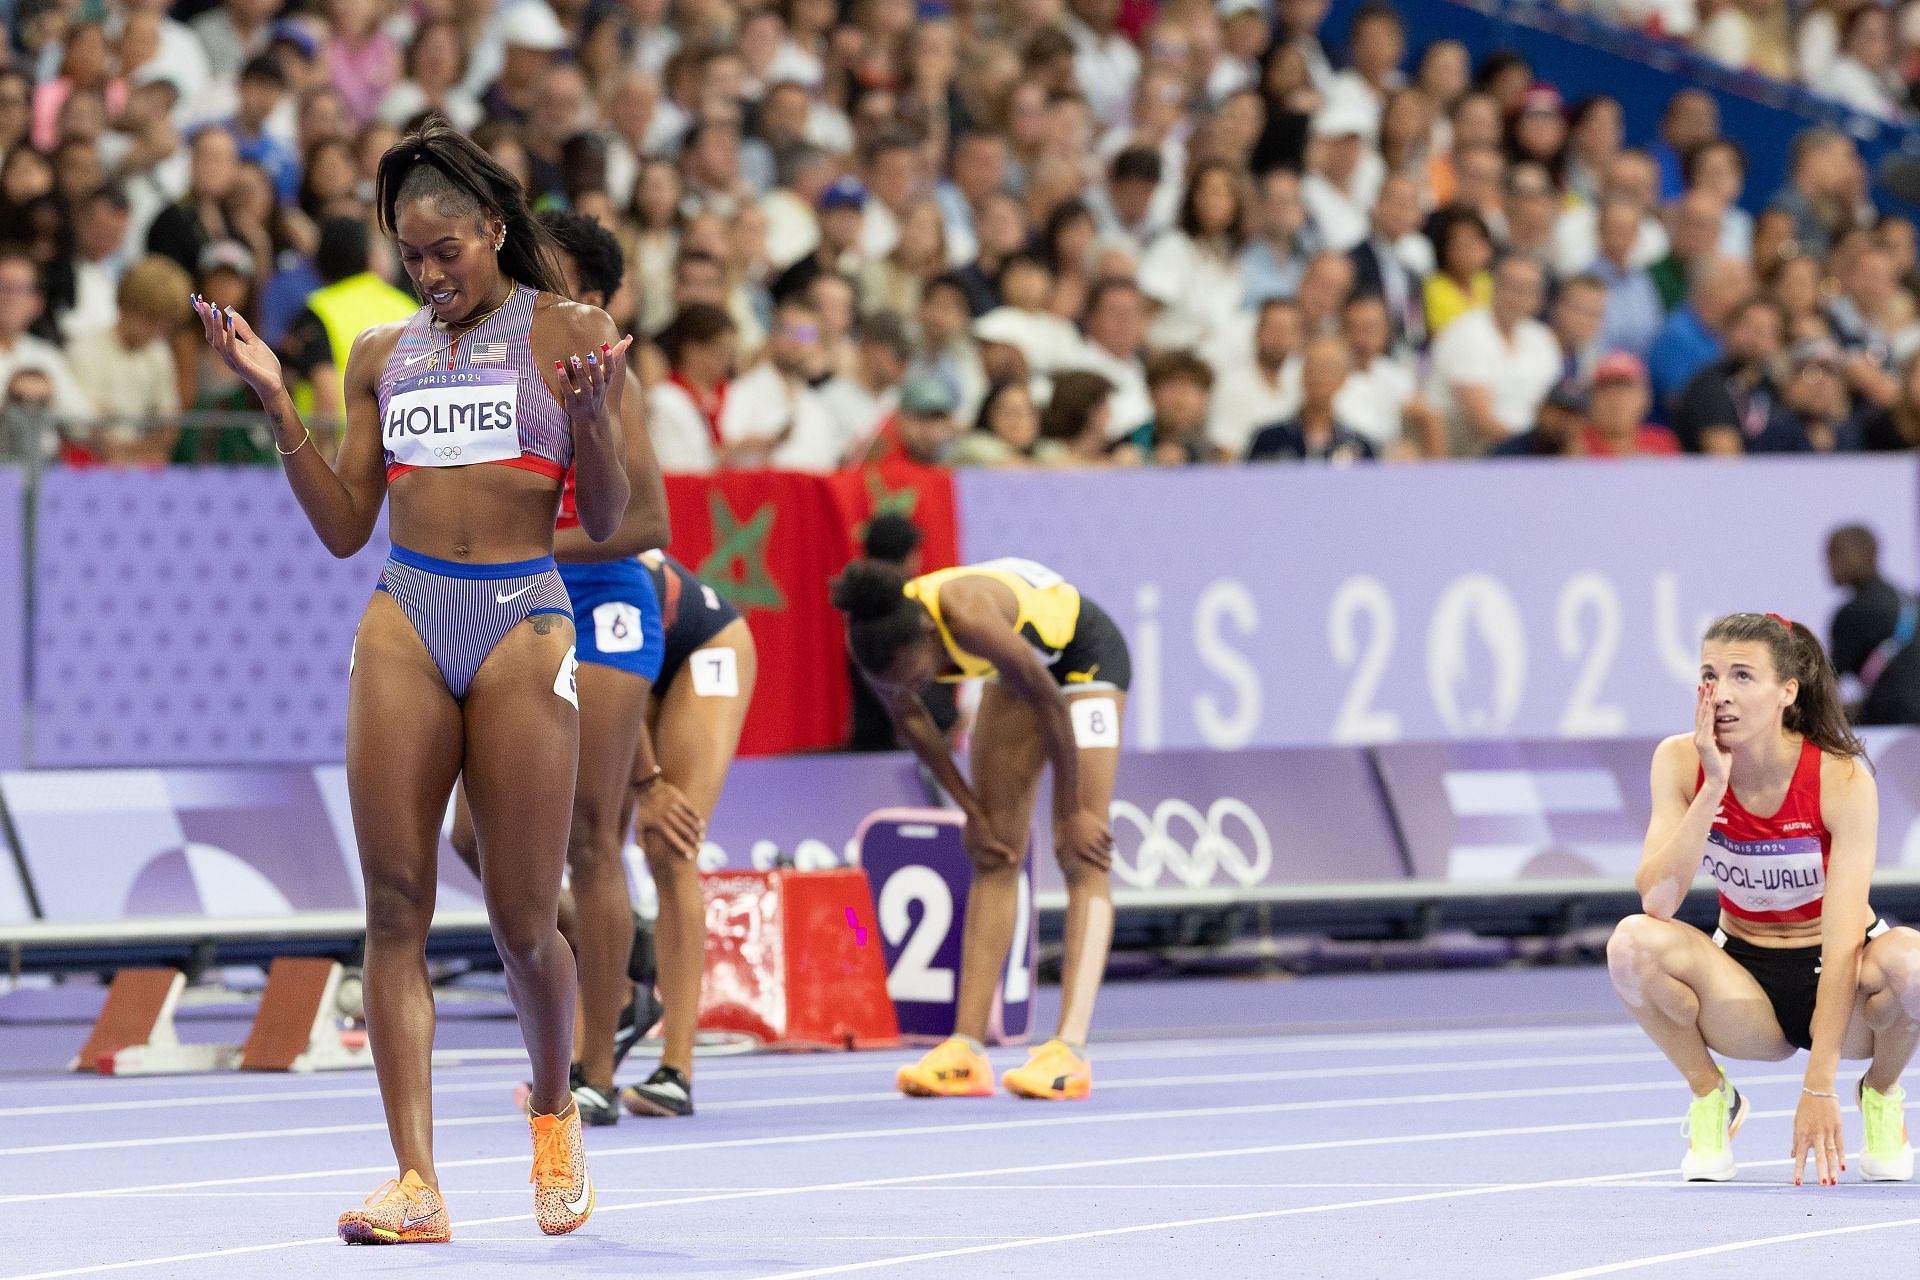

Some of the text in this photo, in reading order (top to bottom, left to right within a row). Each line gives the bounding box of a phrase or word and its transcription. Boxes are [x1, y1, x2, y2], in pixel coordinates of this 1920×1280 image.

[418, 374, 481, 385] PARIS 2024
[388, 401, 513, 438] HOLMES
[612, 614, 628, 639] 6
[708, 660, 722, 683] 7
[1090, 710, 1107, 734] 8
[1755, 844, 1785, 853] 2024
[878, 865, 954, 1003] 2
